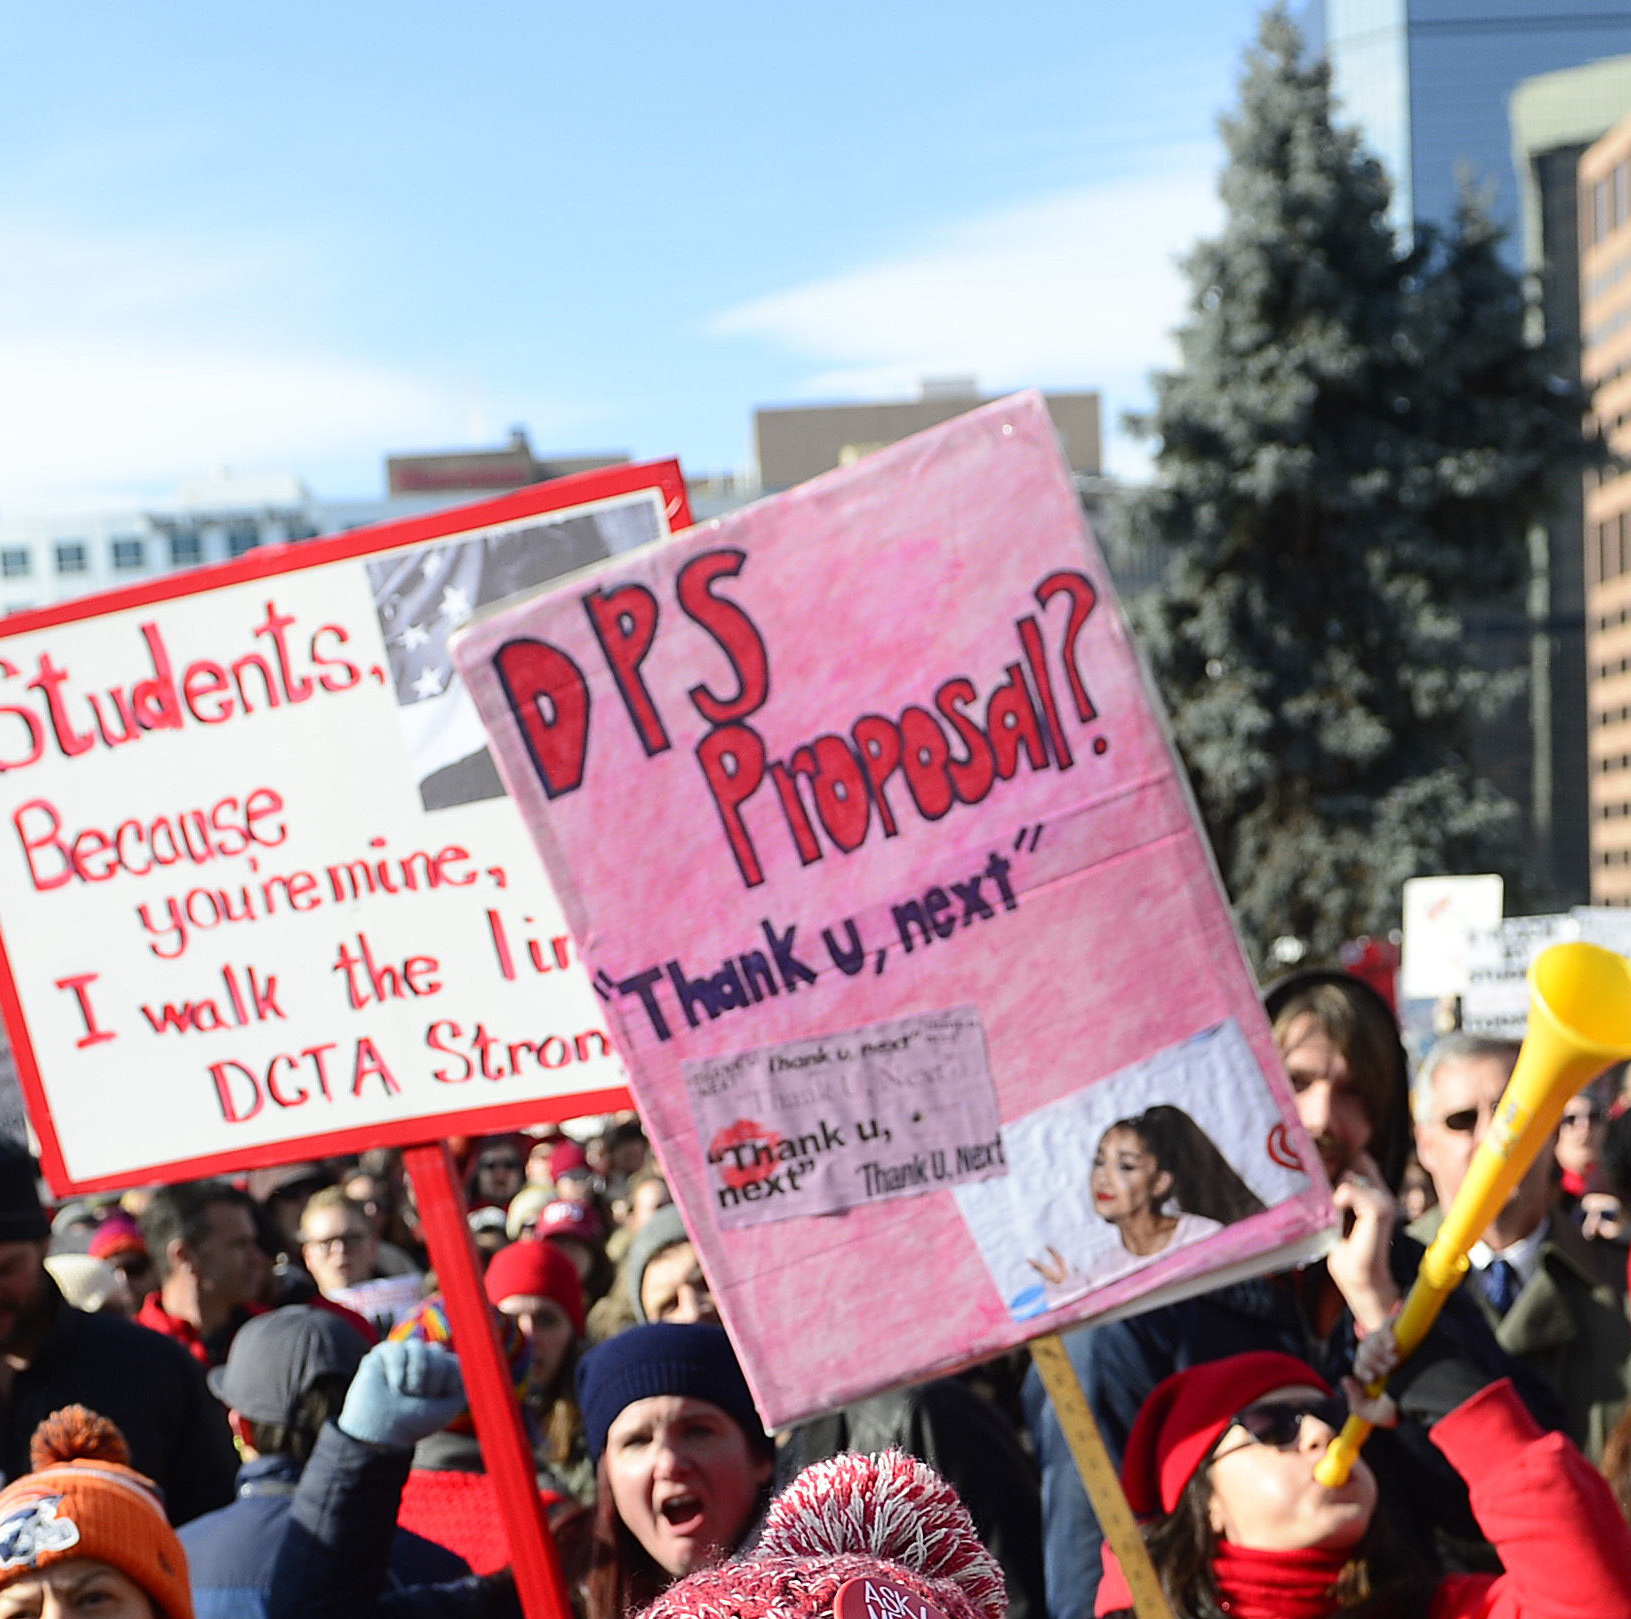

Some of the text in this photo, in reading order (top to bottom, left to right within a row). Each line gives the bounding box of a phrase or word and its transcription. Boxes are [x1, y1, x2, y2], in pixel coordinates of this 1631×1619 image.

[493, 547, 770, 800] DPS
[695, 570, 1110, 889] Proposal?
[13, 786, 287, 893] Because
[55, 972, 116, 1049] I
[141, 963, 288, 1036] walk
[334, 932, 442, 1012] the
[821, 914, 886, 978] u,
[208, 1020, 614, 1124] DCTA Stron
